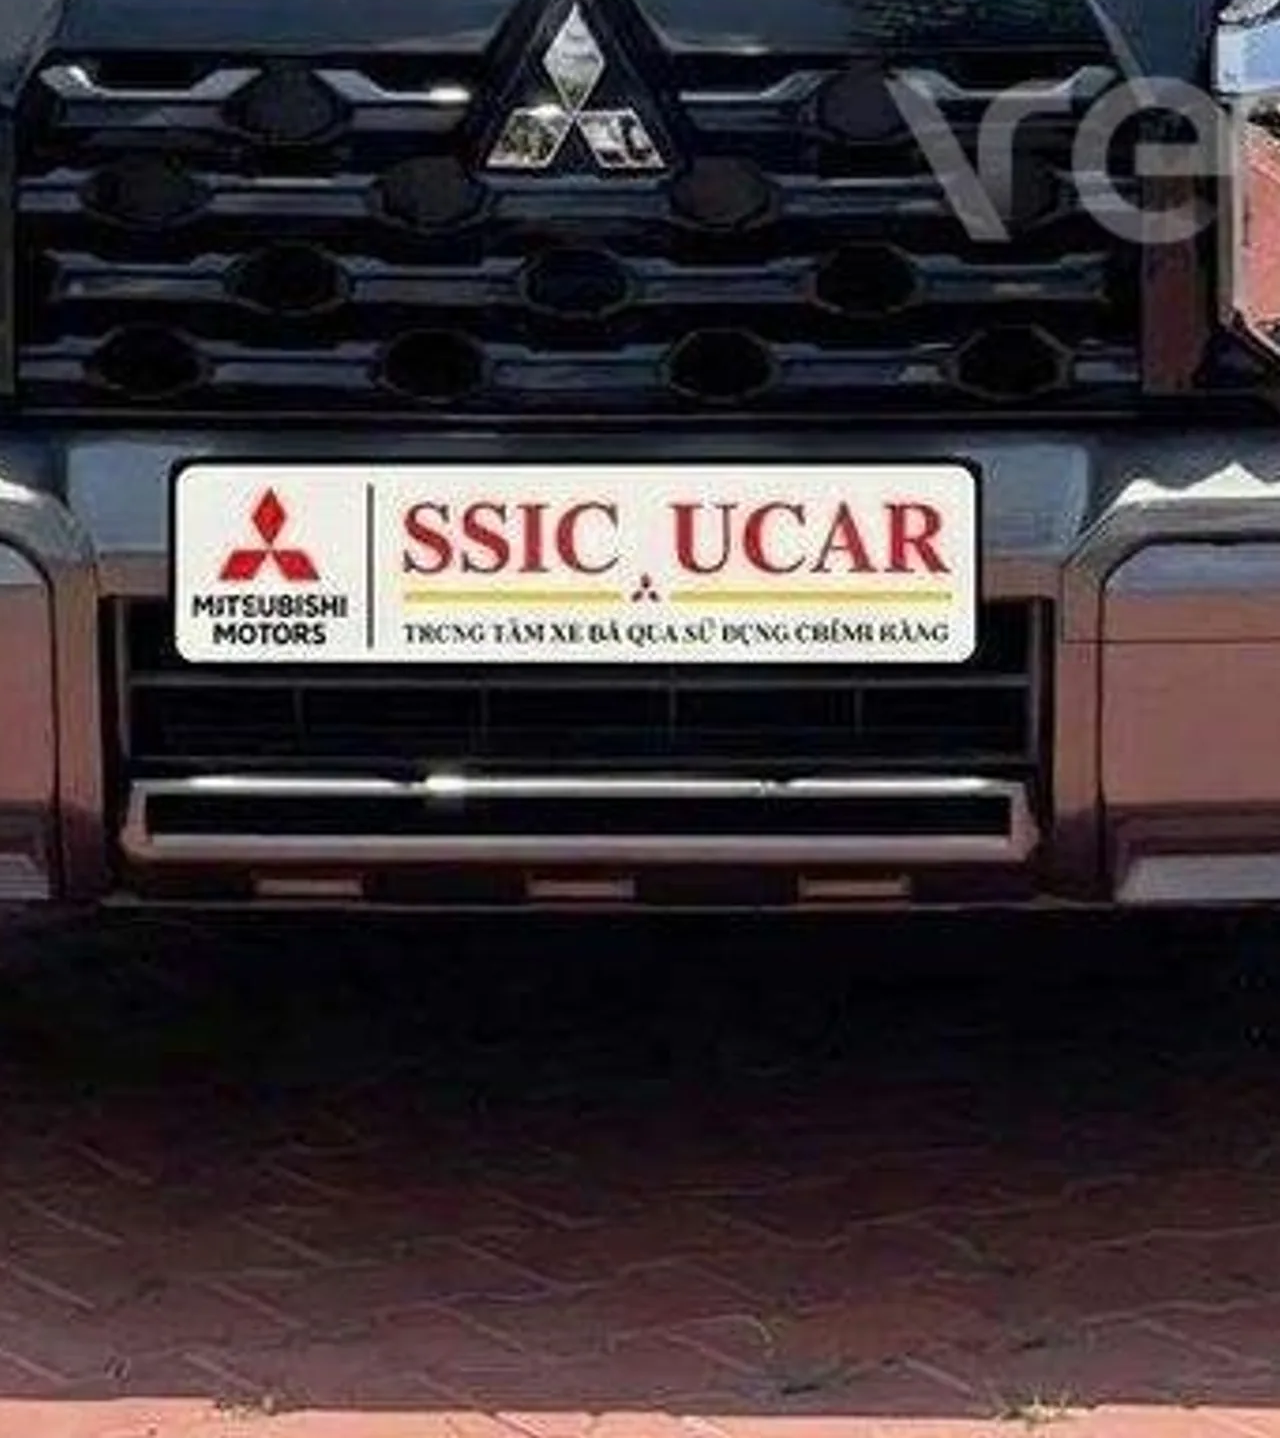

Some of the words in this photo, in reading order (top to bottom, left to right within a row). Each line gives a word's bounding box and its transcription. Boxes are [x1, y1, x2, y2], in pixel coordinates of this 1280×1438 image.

[403, 502, 620, 574] SSIC
[667, 501, 951, 574] UCAR
[192, 594, 349, 618] MITSUBISHI
[213, 622, 326, 644] MOTORS
